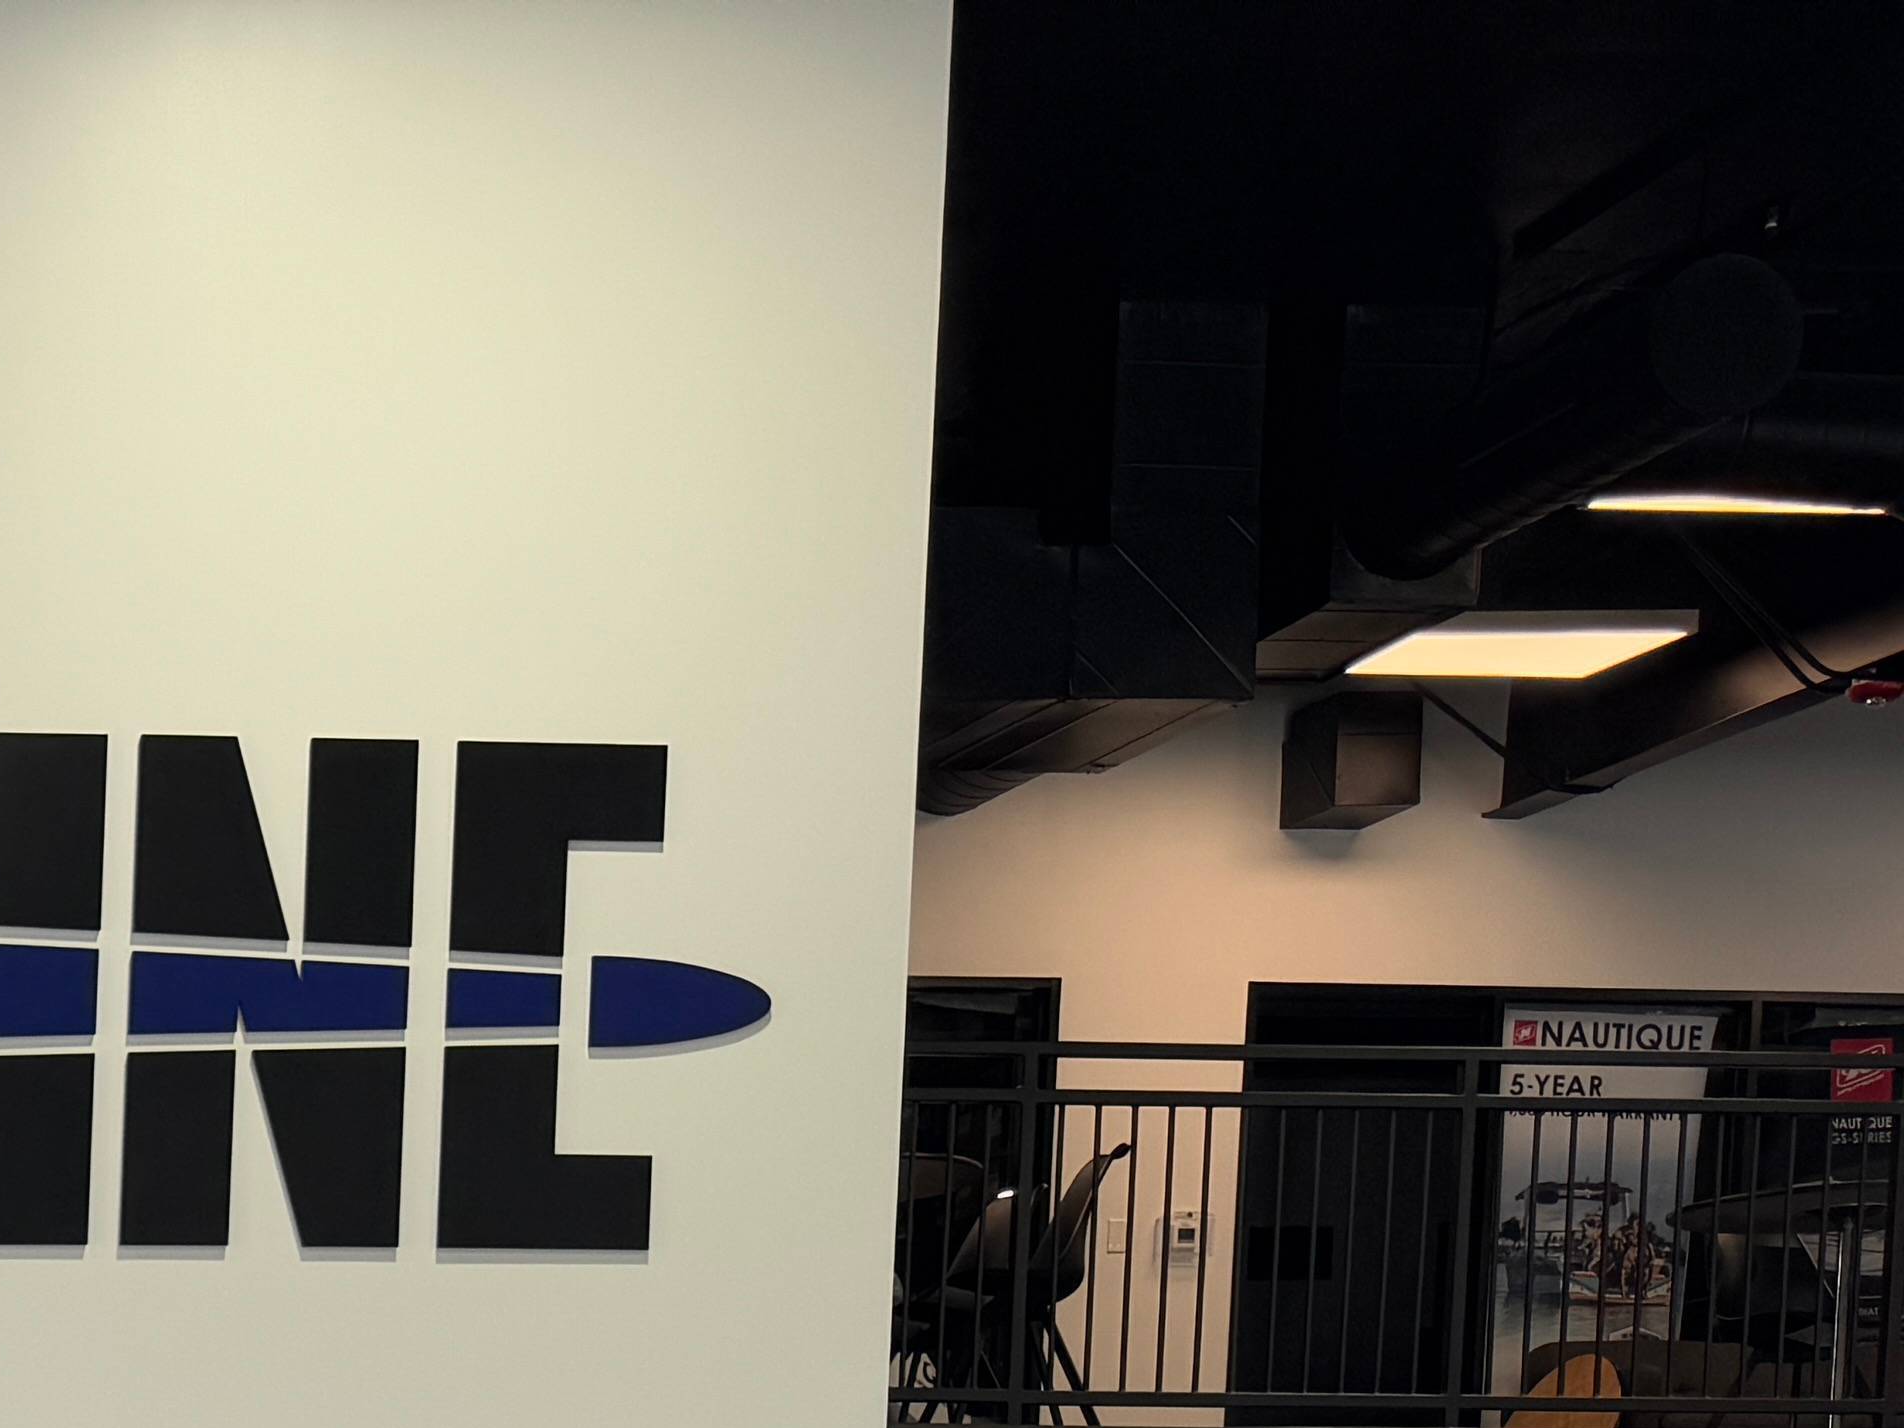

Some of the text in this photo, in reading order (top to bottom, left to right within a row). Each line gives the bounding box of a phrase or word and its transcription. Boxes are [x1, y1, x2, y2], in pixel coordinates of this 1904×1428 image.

[1542, 1020, 1704, 1050] NAUTIQUE
[1509, 1073, 1603, 1097] 5-YEAR
[1832, 1116, 1893, 1129] NAUTQUE
